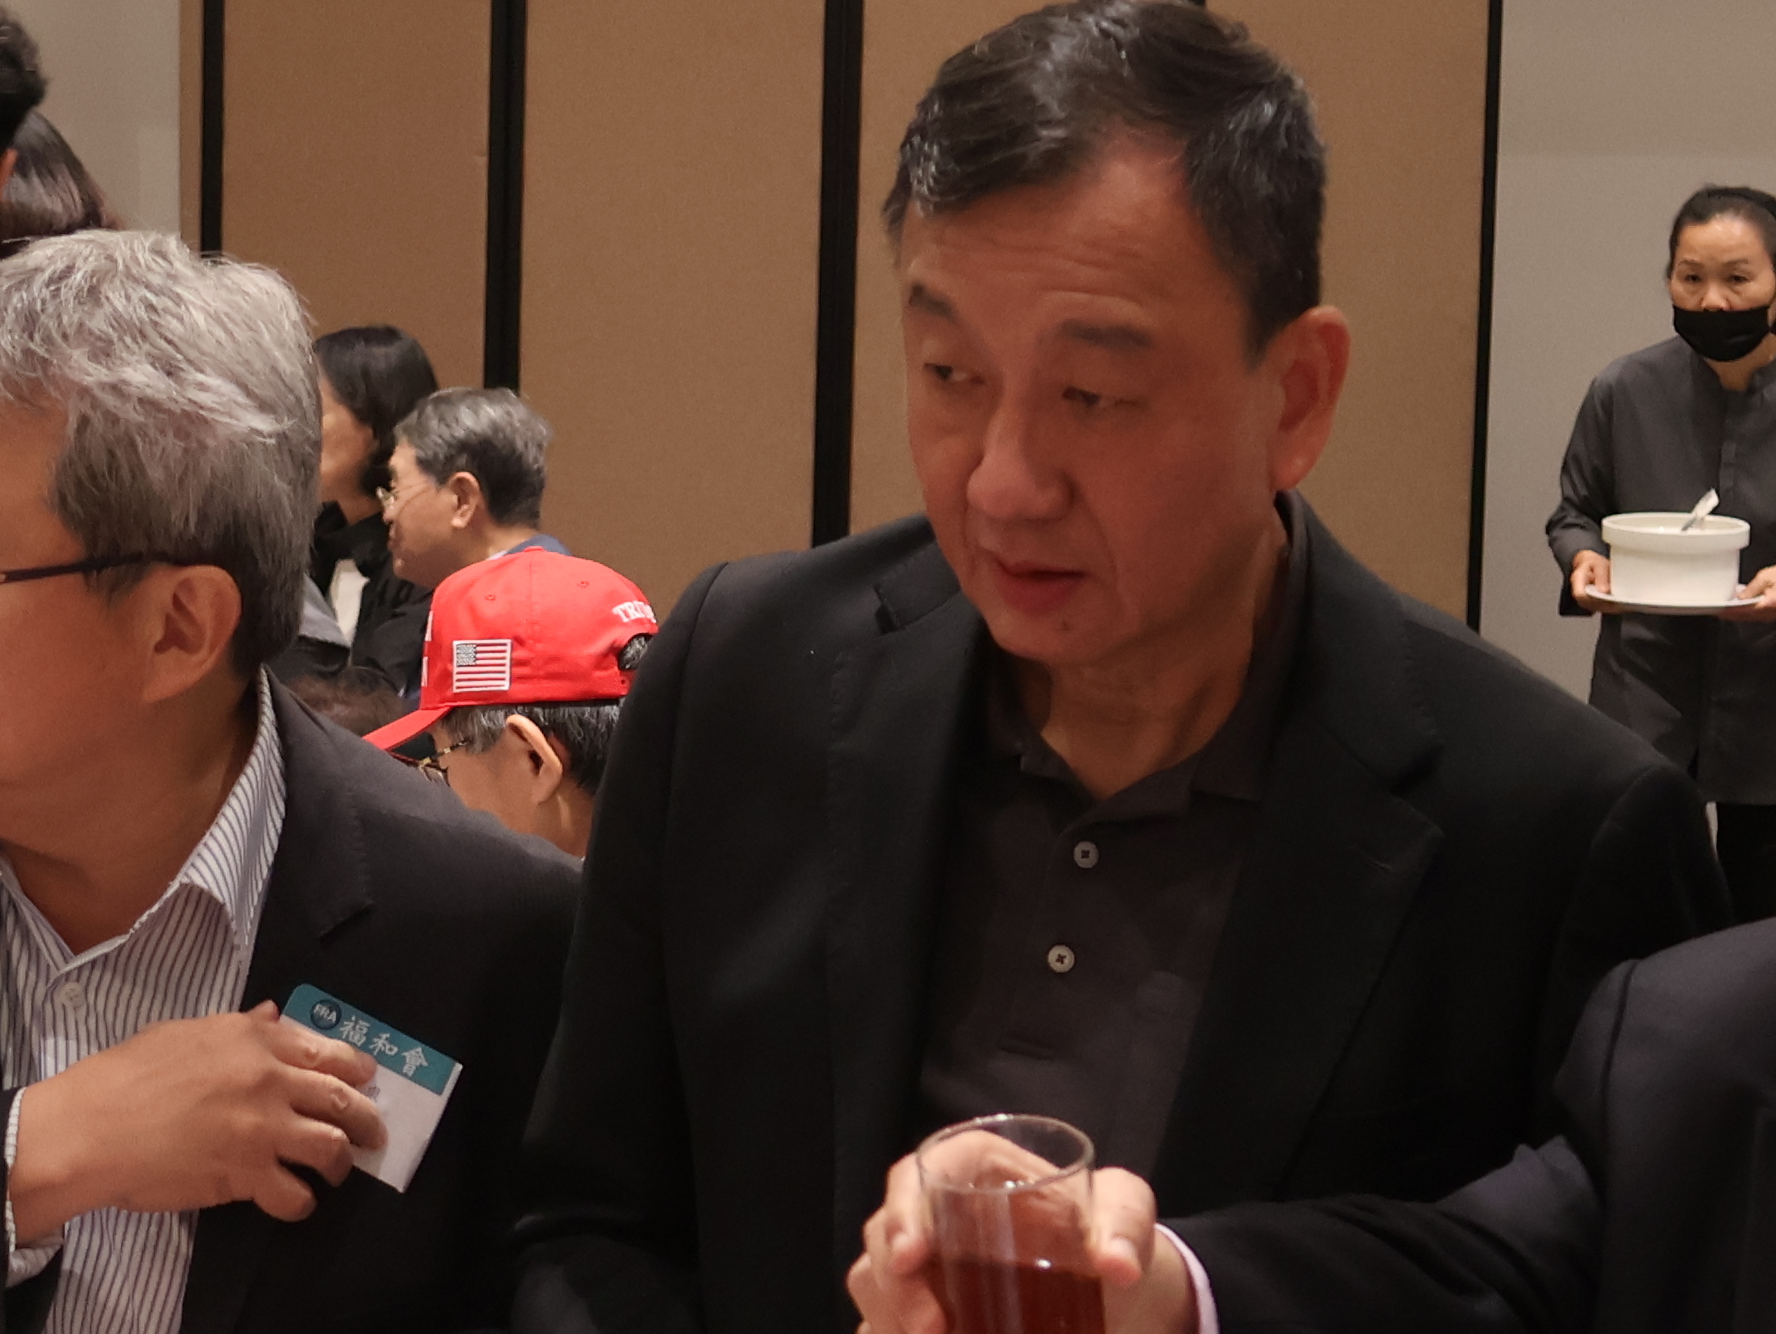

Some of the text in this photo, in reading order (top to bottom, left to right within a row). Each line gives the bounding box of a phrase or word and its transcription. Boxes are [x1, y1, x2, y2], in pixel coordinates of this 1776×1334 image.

[313, 1003, 337, 1024] FRA
[339, 1015, 429, 1077] 福和會
